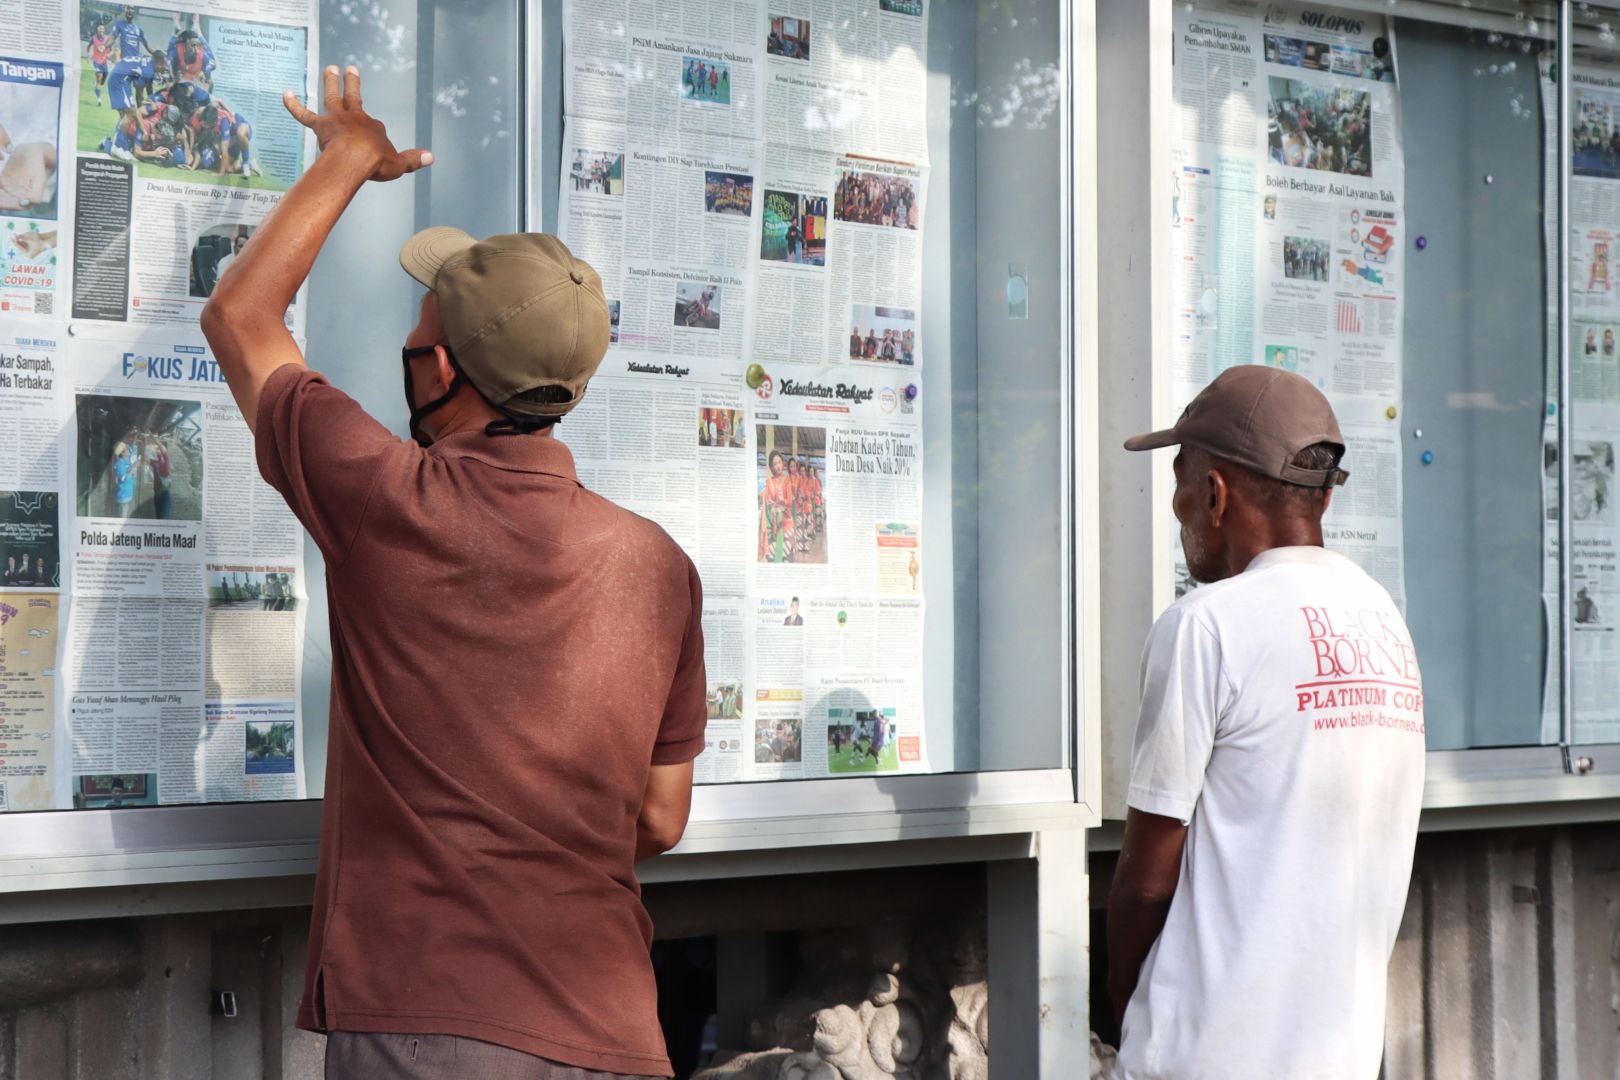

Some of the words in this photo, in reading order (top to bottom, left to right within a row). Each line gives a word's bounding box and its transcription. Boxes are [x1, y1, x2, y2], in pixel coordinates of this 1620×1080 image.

[1299, 9, 1364, 35] SOLOPOS
[1213, 27, 1247, 42] Upayakan
[653, 41, 685, 53] Amankan
[1230, 42, 1252, 54] SMAN
[1, 61, 57, 81] Tangan
[146, 182, 165, 192] Desa
[210, 189, 222, 200] Rp
[223, 190, 228, 198] 2
[1266, 174, 1288, 189] Boleh
[1290, 178, 1326, 195] Berbayar
[1328, 183, 1345, 196] Asal
[1346, 185, 1379, 201] Layanan
[11, 264, 46, 275] LAWAN
[4, 275, 34, 286] COVID
[16, 354, 54, 374] Sampah,
[664, 364, 690, 378] Rakyat
[13, 374, 53, 390] Terbakar
[836, 383, 874, 404] Rakyat
[829, 435, 859, 454] Jabatan
[861, 437, 884, 455] Kades
[885, 438, 890, 455] 9
[892, 439, 916, 458] Tahun,
[835, 454, 855, 473] Dana
[856, 455, 875, 473] Desa
[876, 456, 893, 475] Naik
[894, 457, 910, 476] 20%
[81, 530, 108, 546] Polda
[109, 531, 142, 550] Jateng
[143, 532, 171, 548] Minta
[172, 533, 197, 548] Maaf
[1340, 530, 1356, 540] ASN
[1356, 530, 1378, 541] Netral
[1297, 687, 1387, 712] PLATINUM
